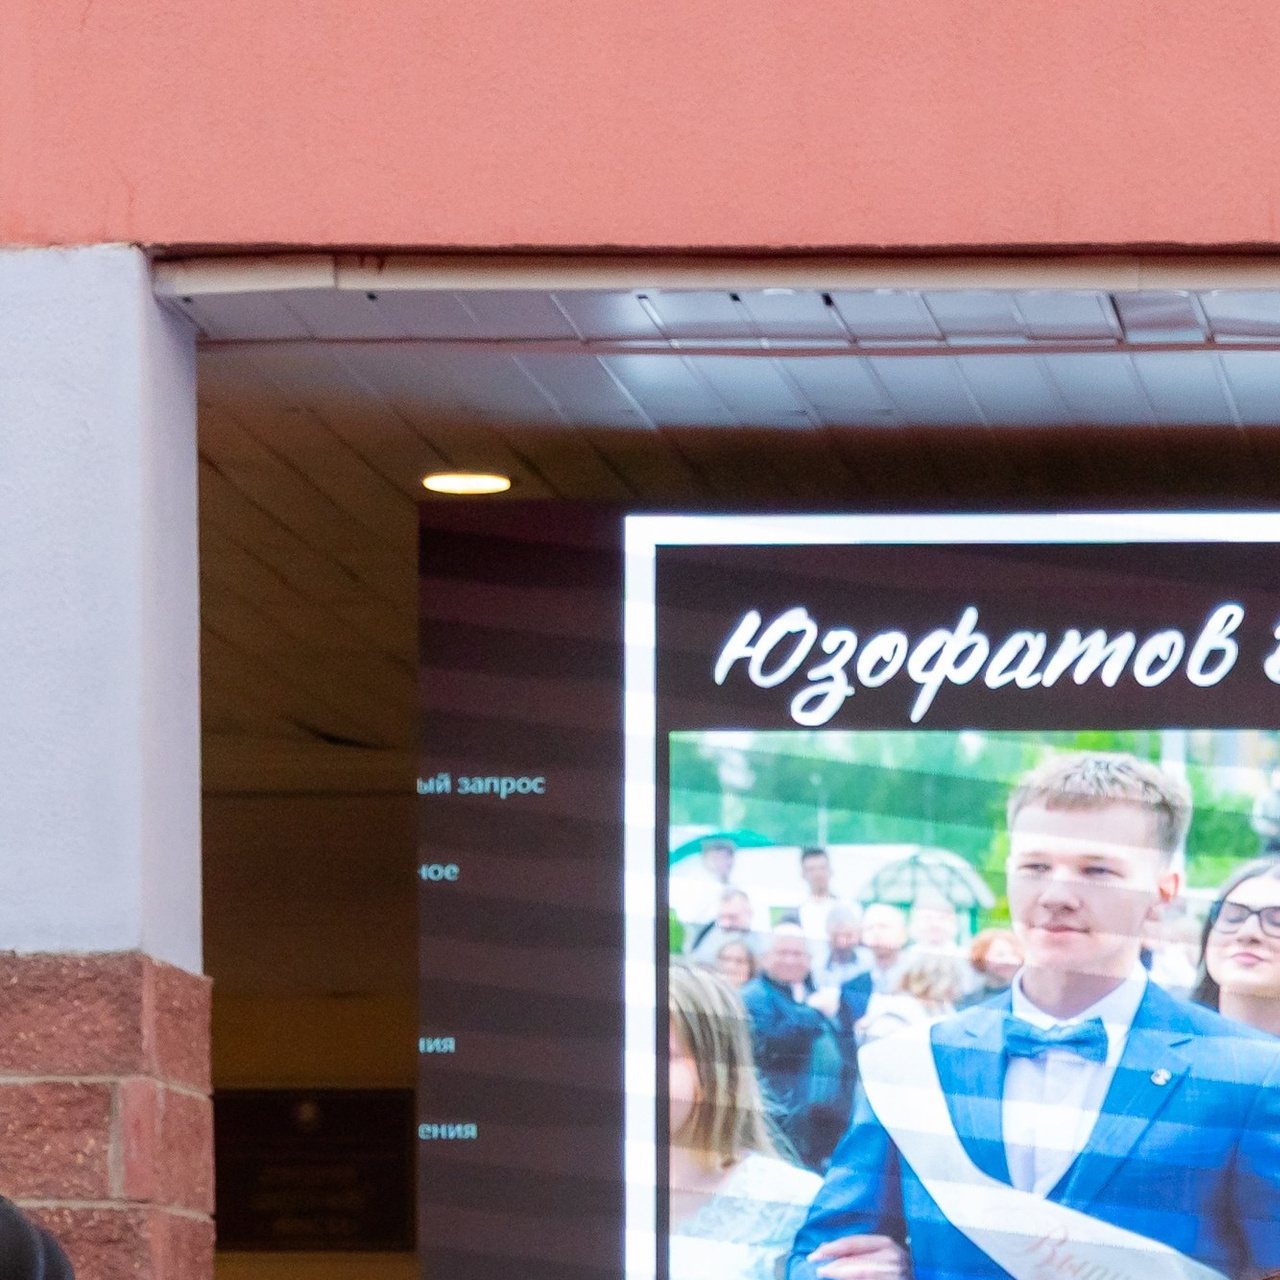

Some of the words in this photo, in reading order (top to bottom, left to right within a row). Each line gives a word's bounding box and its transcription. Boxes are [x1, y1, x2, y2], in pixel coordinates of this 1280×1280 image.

[714, 604, 1244, 726] Юзофатов
[457, 776, 547, 800] запрос
[418, 1123, 478, 1140] ения
